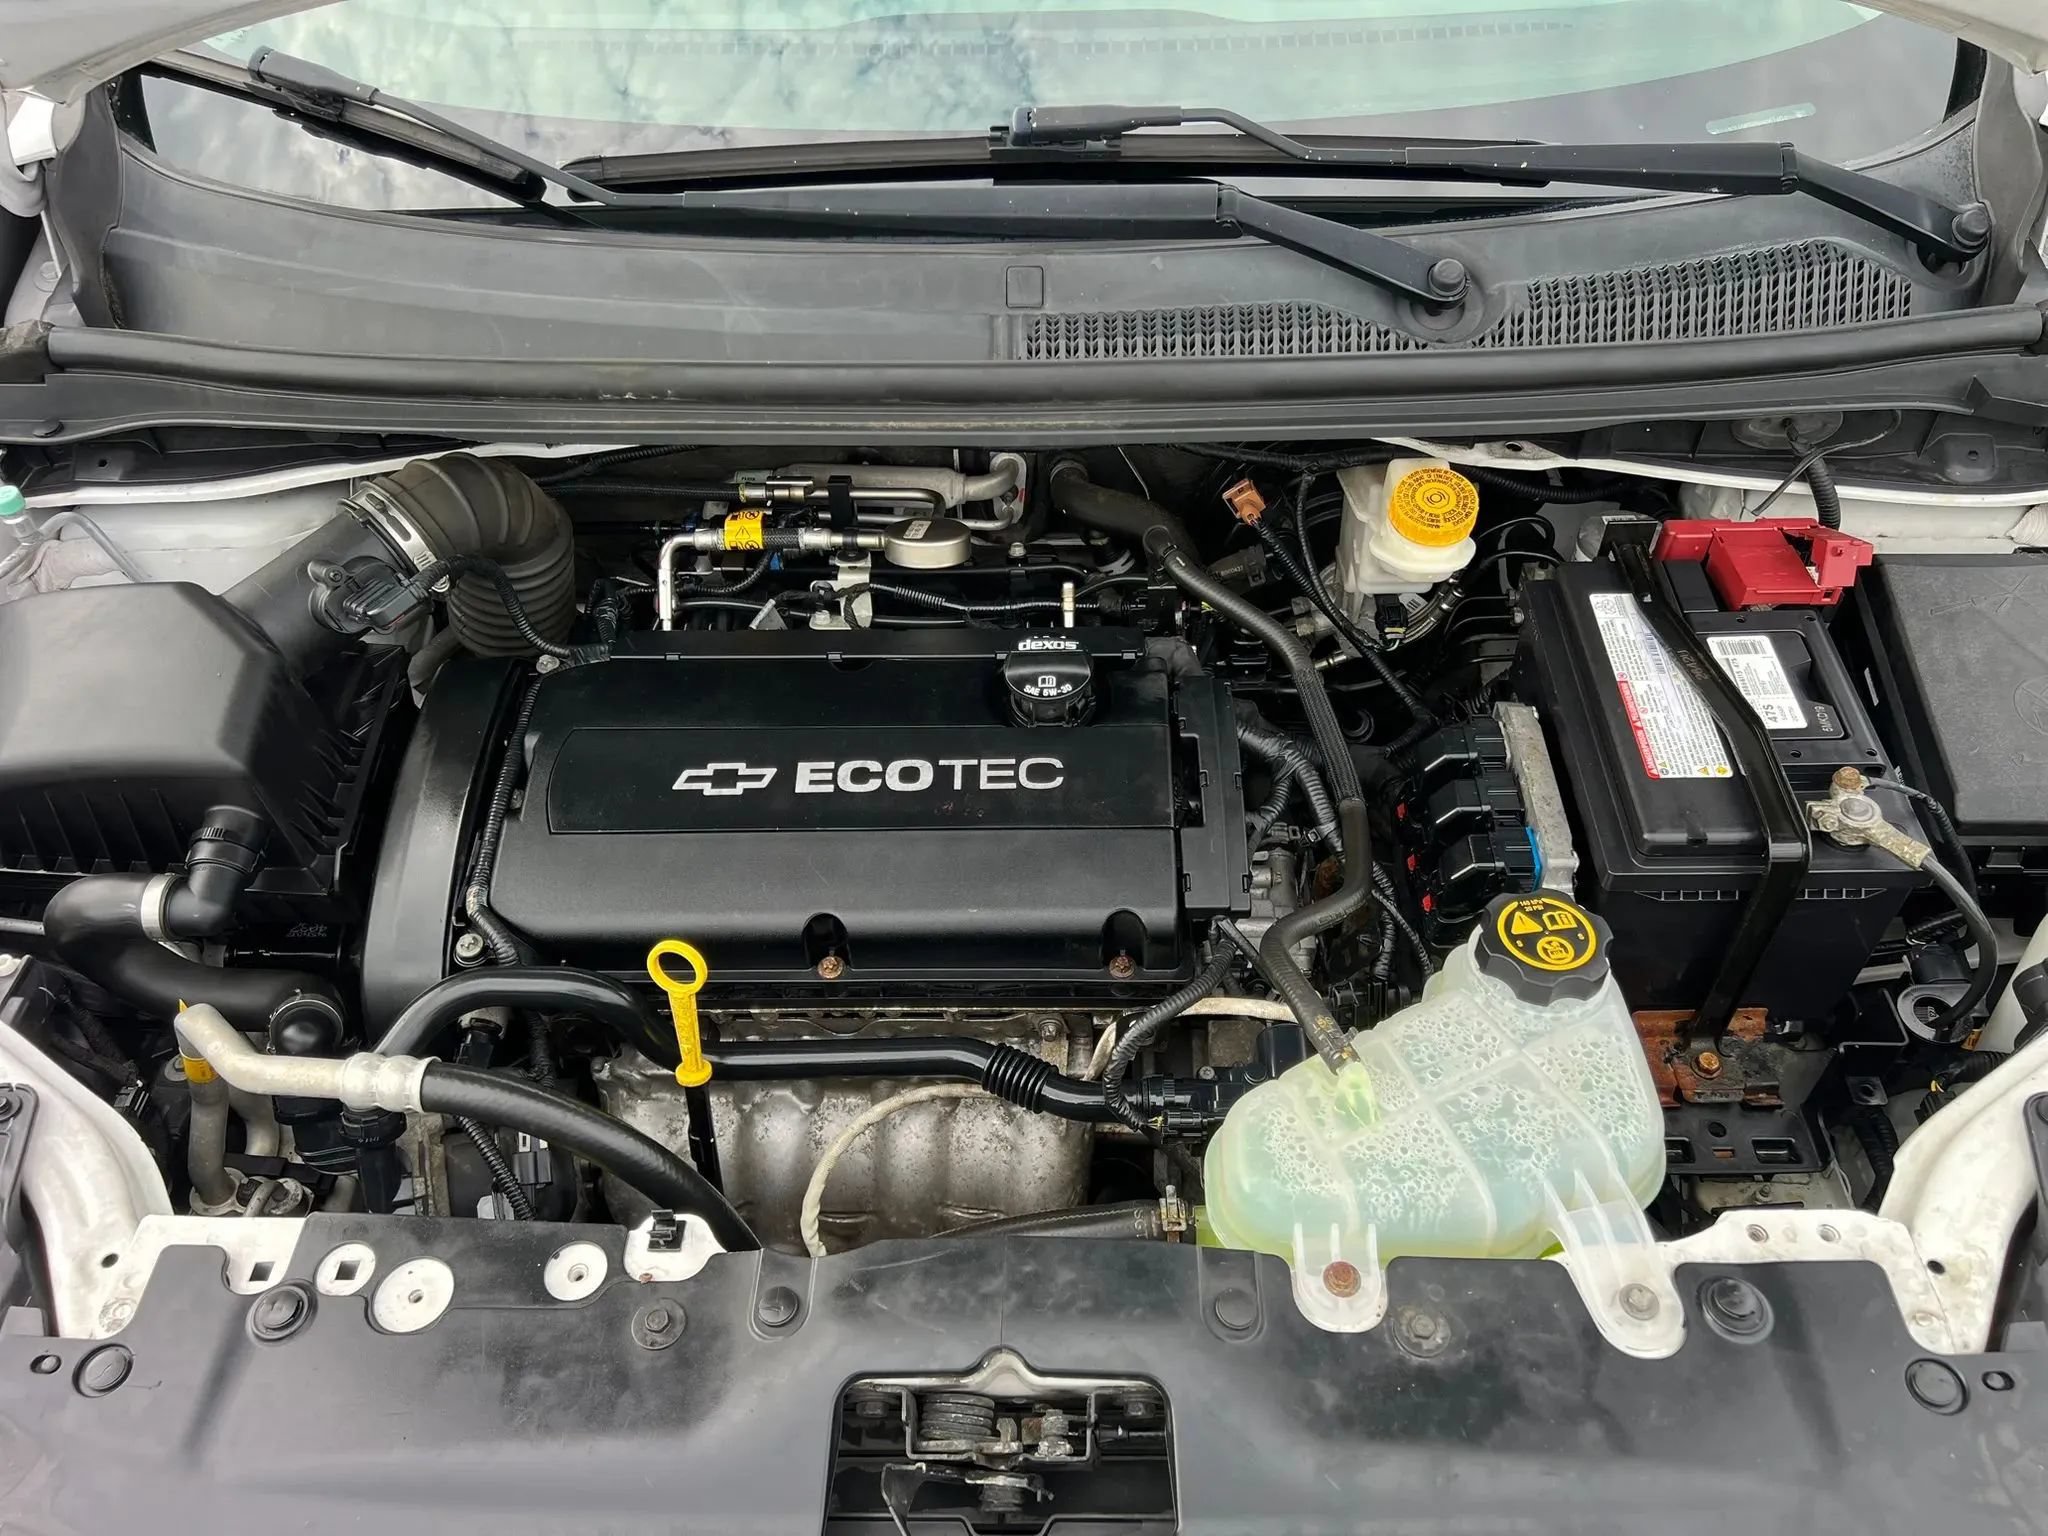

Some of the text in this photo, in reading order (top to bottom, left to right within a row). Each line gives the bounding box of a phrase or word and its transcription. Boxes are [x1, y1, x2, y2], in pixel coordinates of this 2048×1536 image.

[1018, 639, 1079, 651] dexos
[1023, 683, 1073, 697] SAE 5W-30
[1762, 704, 1779, 723] 47S
[795, 757, 1064, 794] ECOTEC
